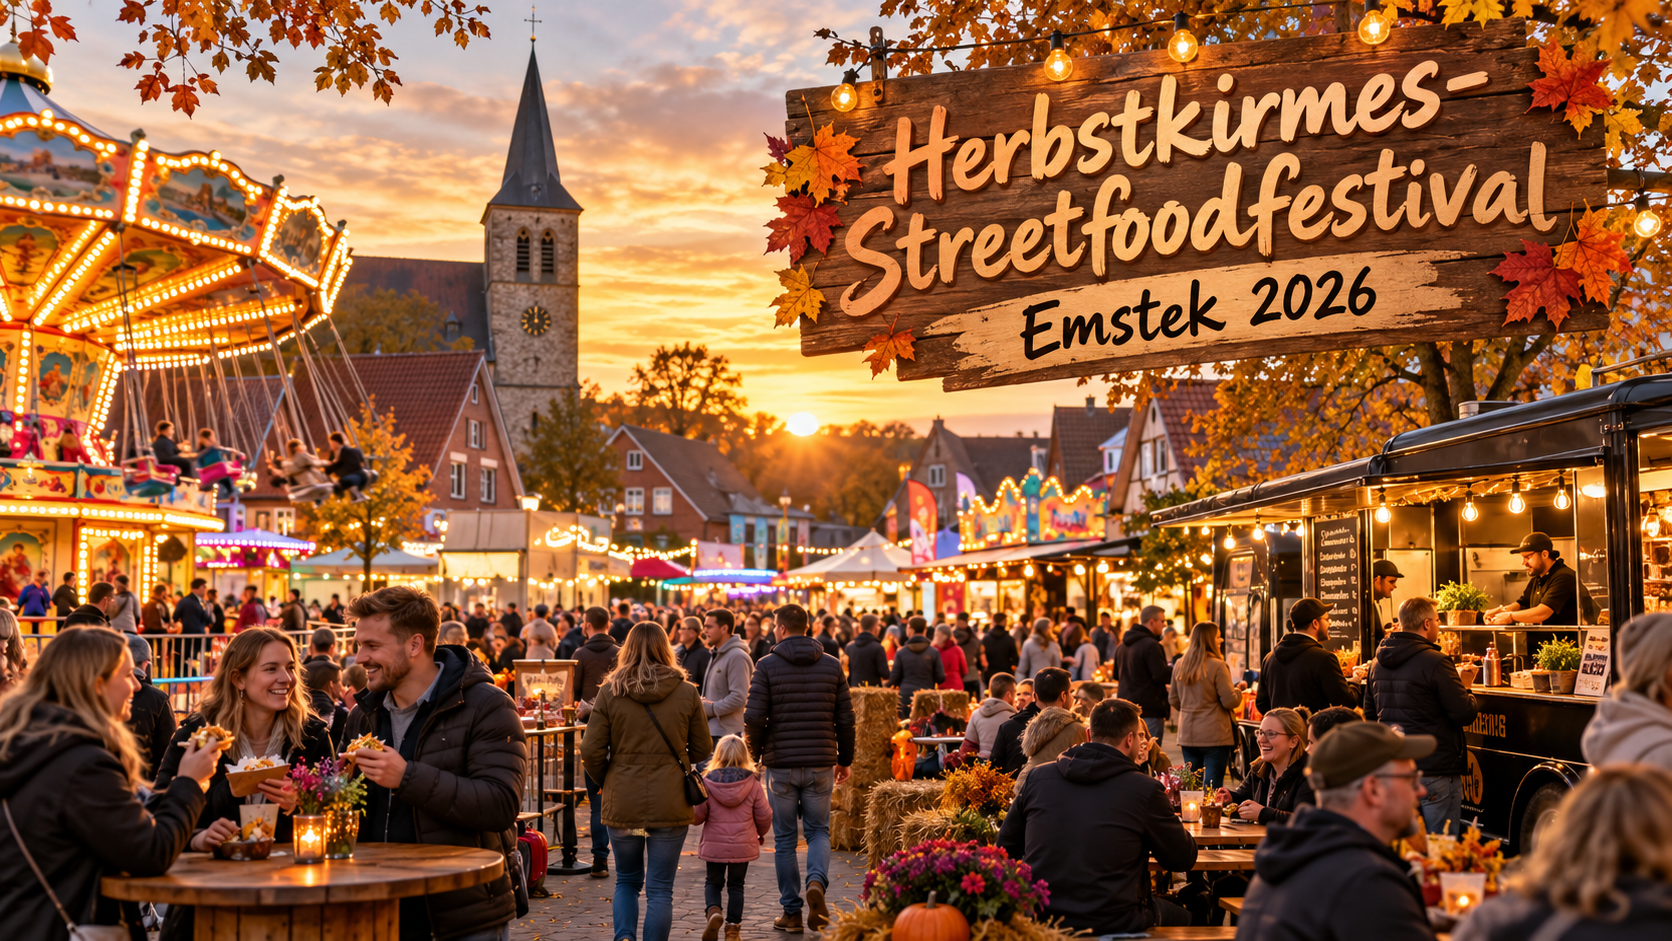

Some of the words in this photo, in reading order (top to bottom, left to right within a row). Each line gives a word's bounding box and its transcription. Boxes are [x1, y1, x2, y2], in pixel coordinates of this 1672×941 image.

[883, 59, 1489, 205] Herbstkirmes-
[839, 141, 1557, 318] Streetfoodfestival
[1020, 279, 1226, 360] Emstek
[1250, 266, 1377, 326] 2026
